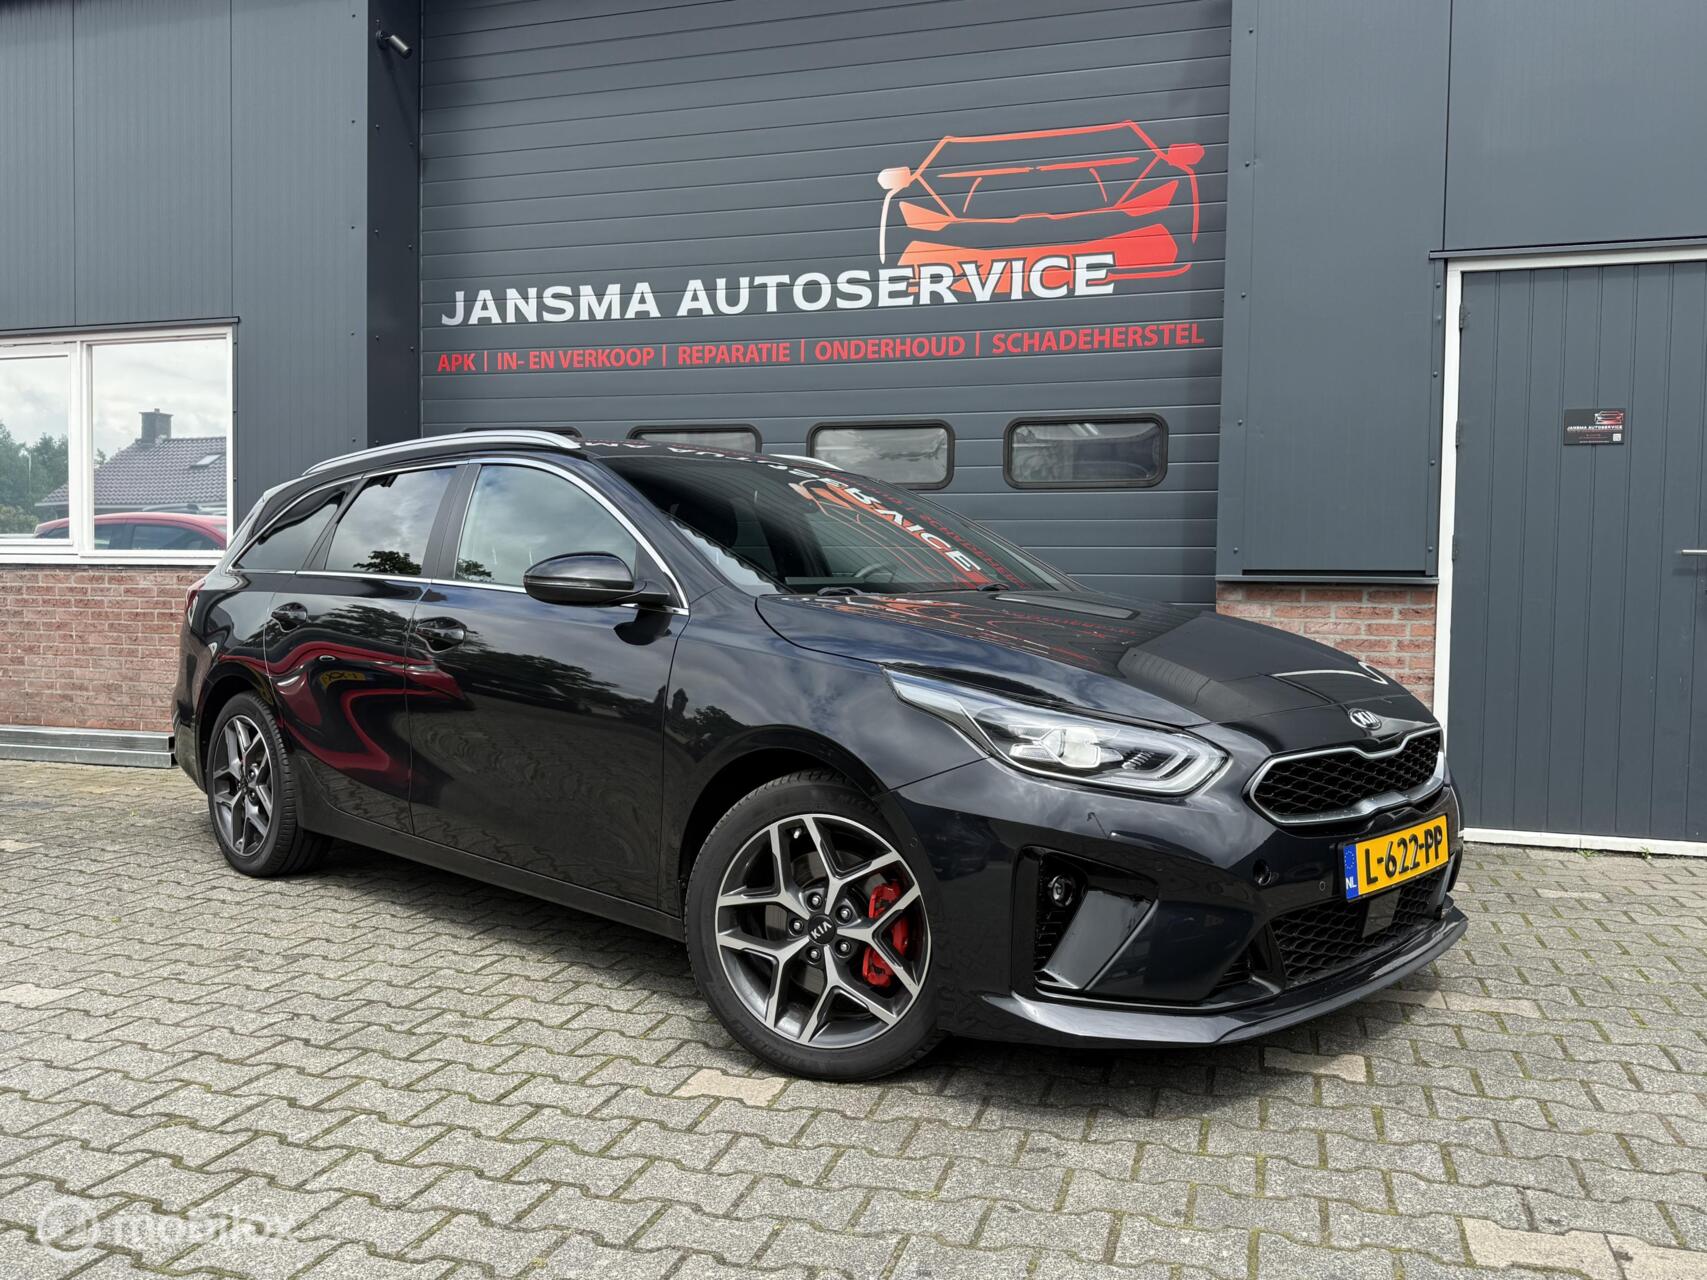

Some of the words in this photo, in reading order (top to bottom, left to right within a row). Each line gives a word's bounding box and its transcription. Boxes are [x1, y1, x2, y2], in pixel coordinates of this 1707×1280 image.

[441, 282, 660, 326] JANSMA
[676, 253, 1115, 318] AUTOSERVICE
[437, 352, 477, 373] APK
[497, 352, 525, 371] IN-
[529, 350, 560, 370] EN
[559, 346, 655, 369] VERKOOP
[678, 342, 791, 365] REPARATIE
[815, 335, 966, 361] ONDERHOUD
[991, 323, 1205, 354] SCHADEHERSTEL
[1364, 825, 1443, 886] L-622-PP
[1345, 876, 1357, 889] NL
[810, 921, 832, 939] KIA
